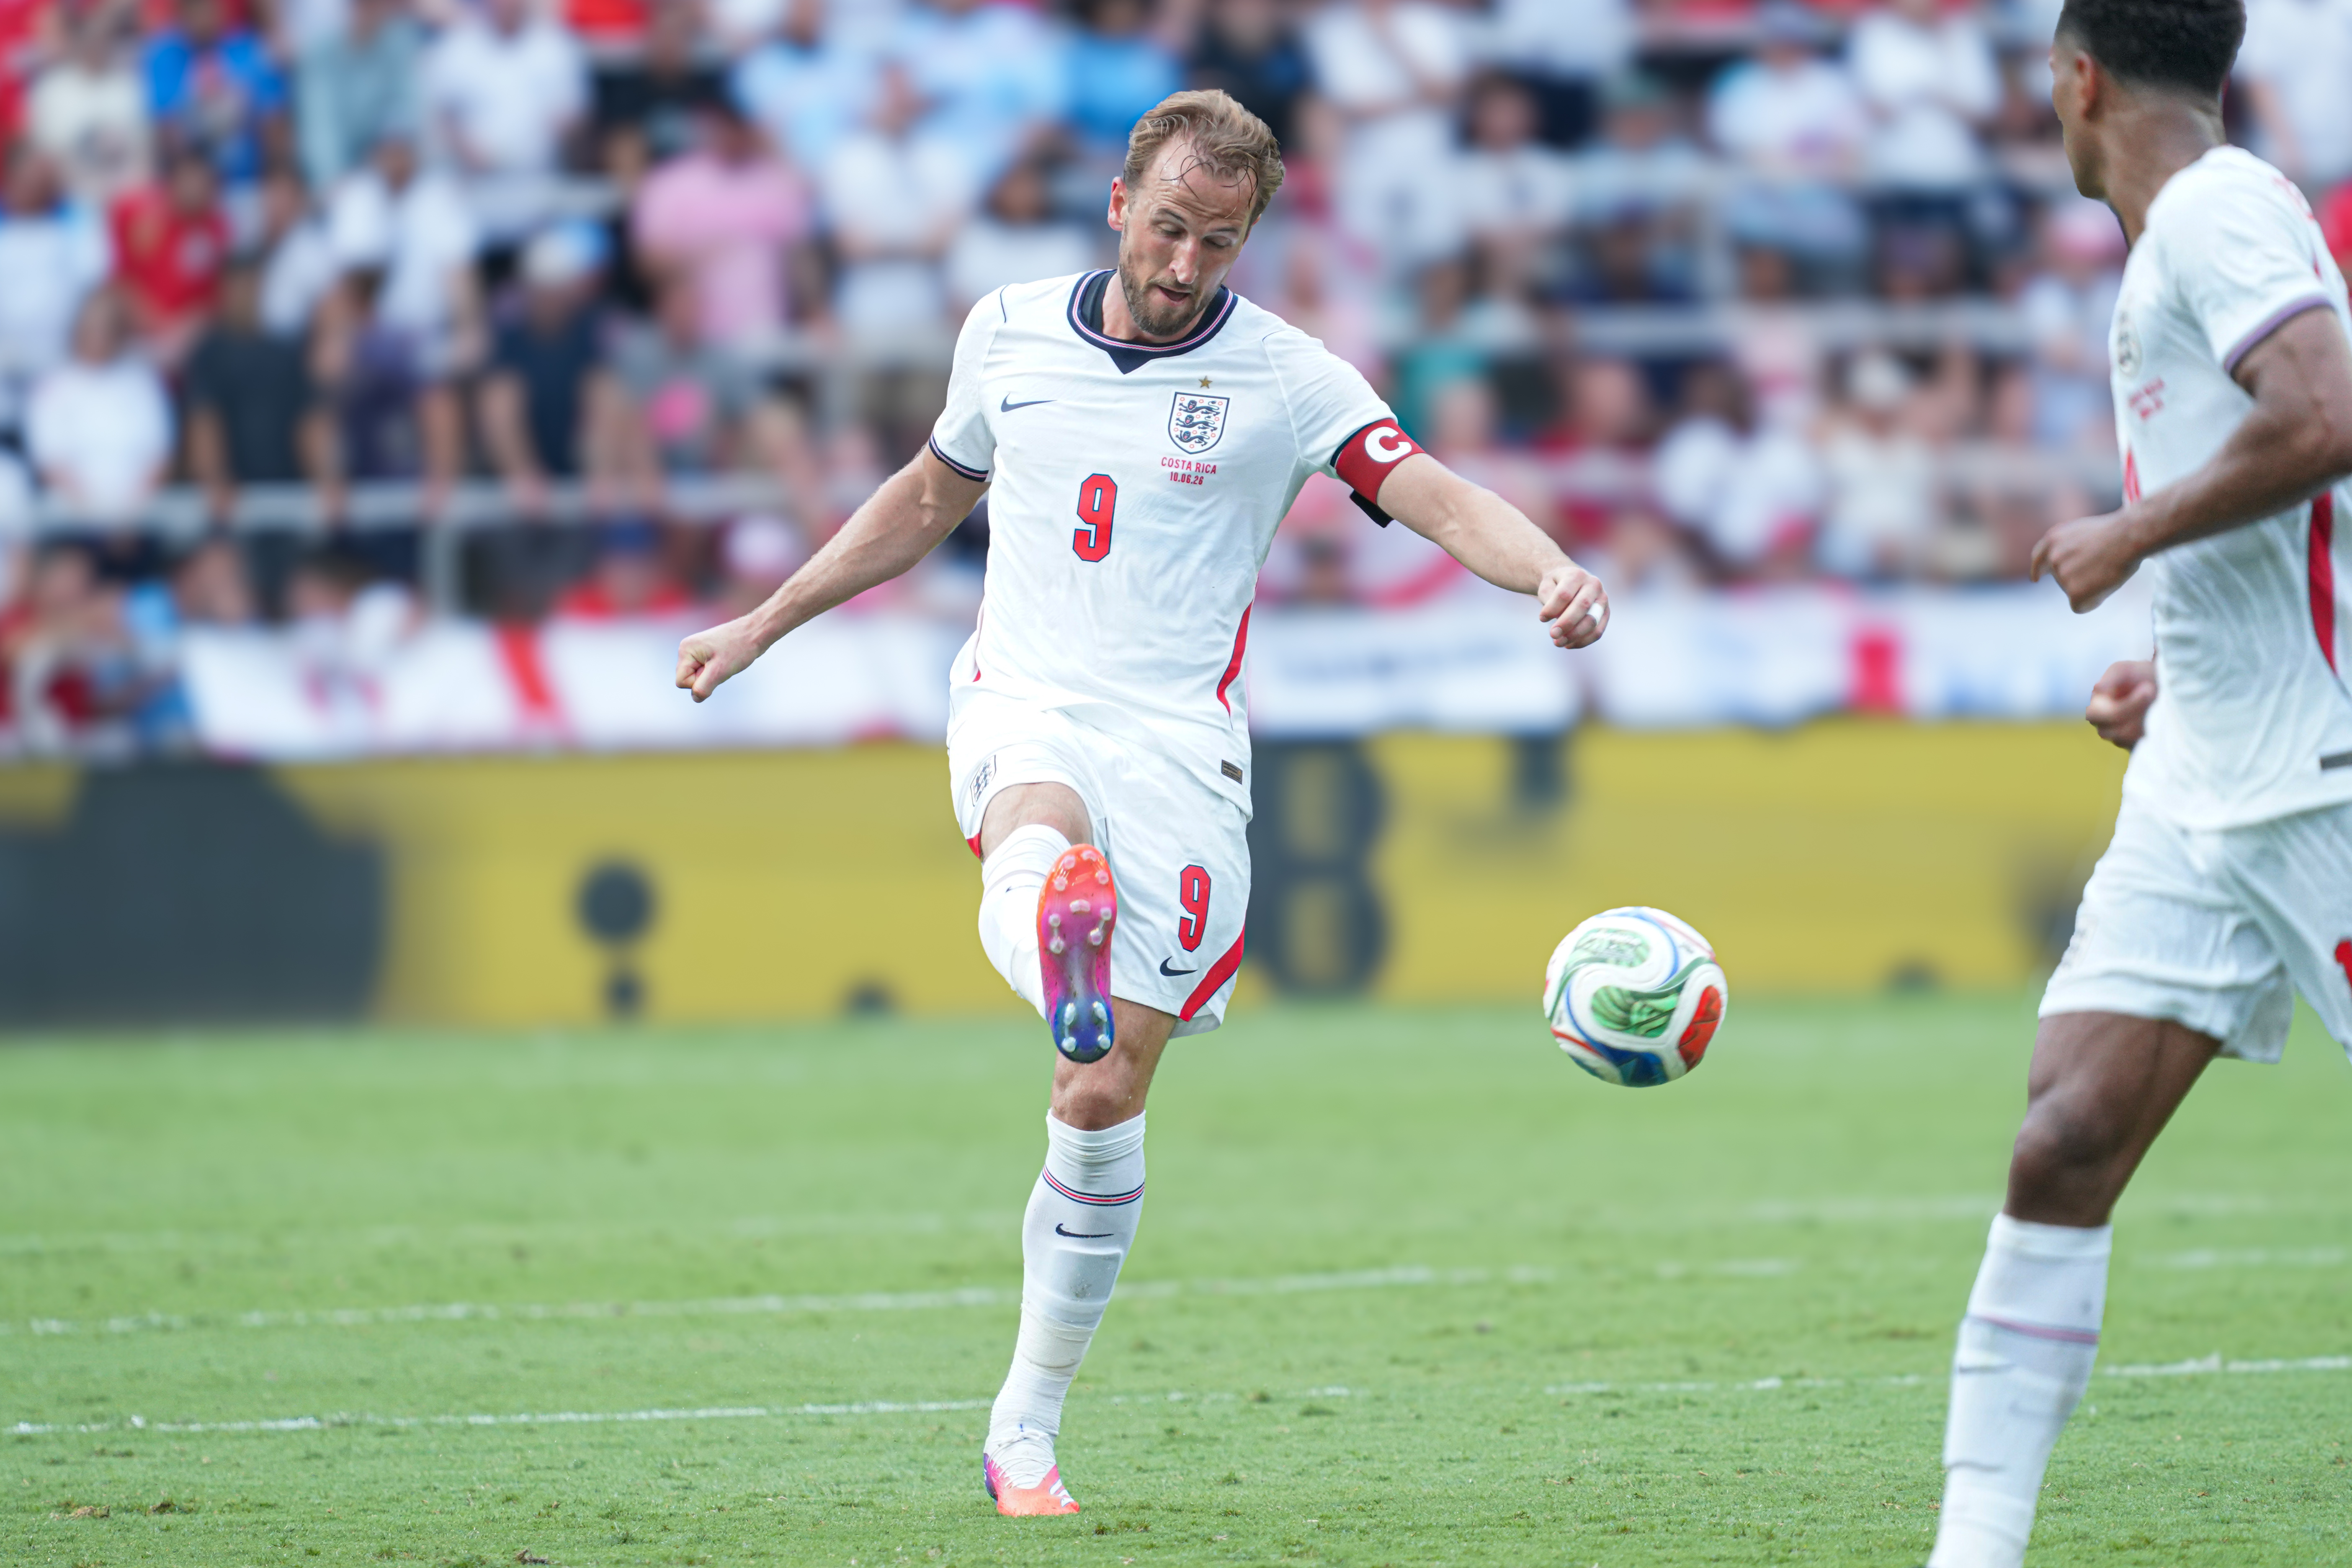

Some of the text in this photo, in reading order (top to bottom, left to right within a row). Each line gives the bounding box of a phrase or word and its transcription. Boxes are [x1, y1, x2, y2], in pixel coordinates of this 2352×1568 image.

[1365, 426, 1412, 463] C
[1161, 457, 1216, 474] COSTA RICA
[1170, 471, 1204, 485] 10.06.26
[1072, 473, 1118, 563] 9
[1178, 864, 1211, 953] 9
